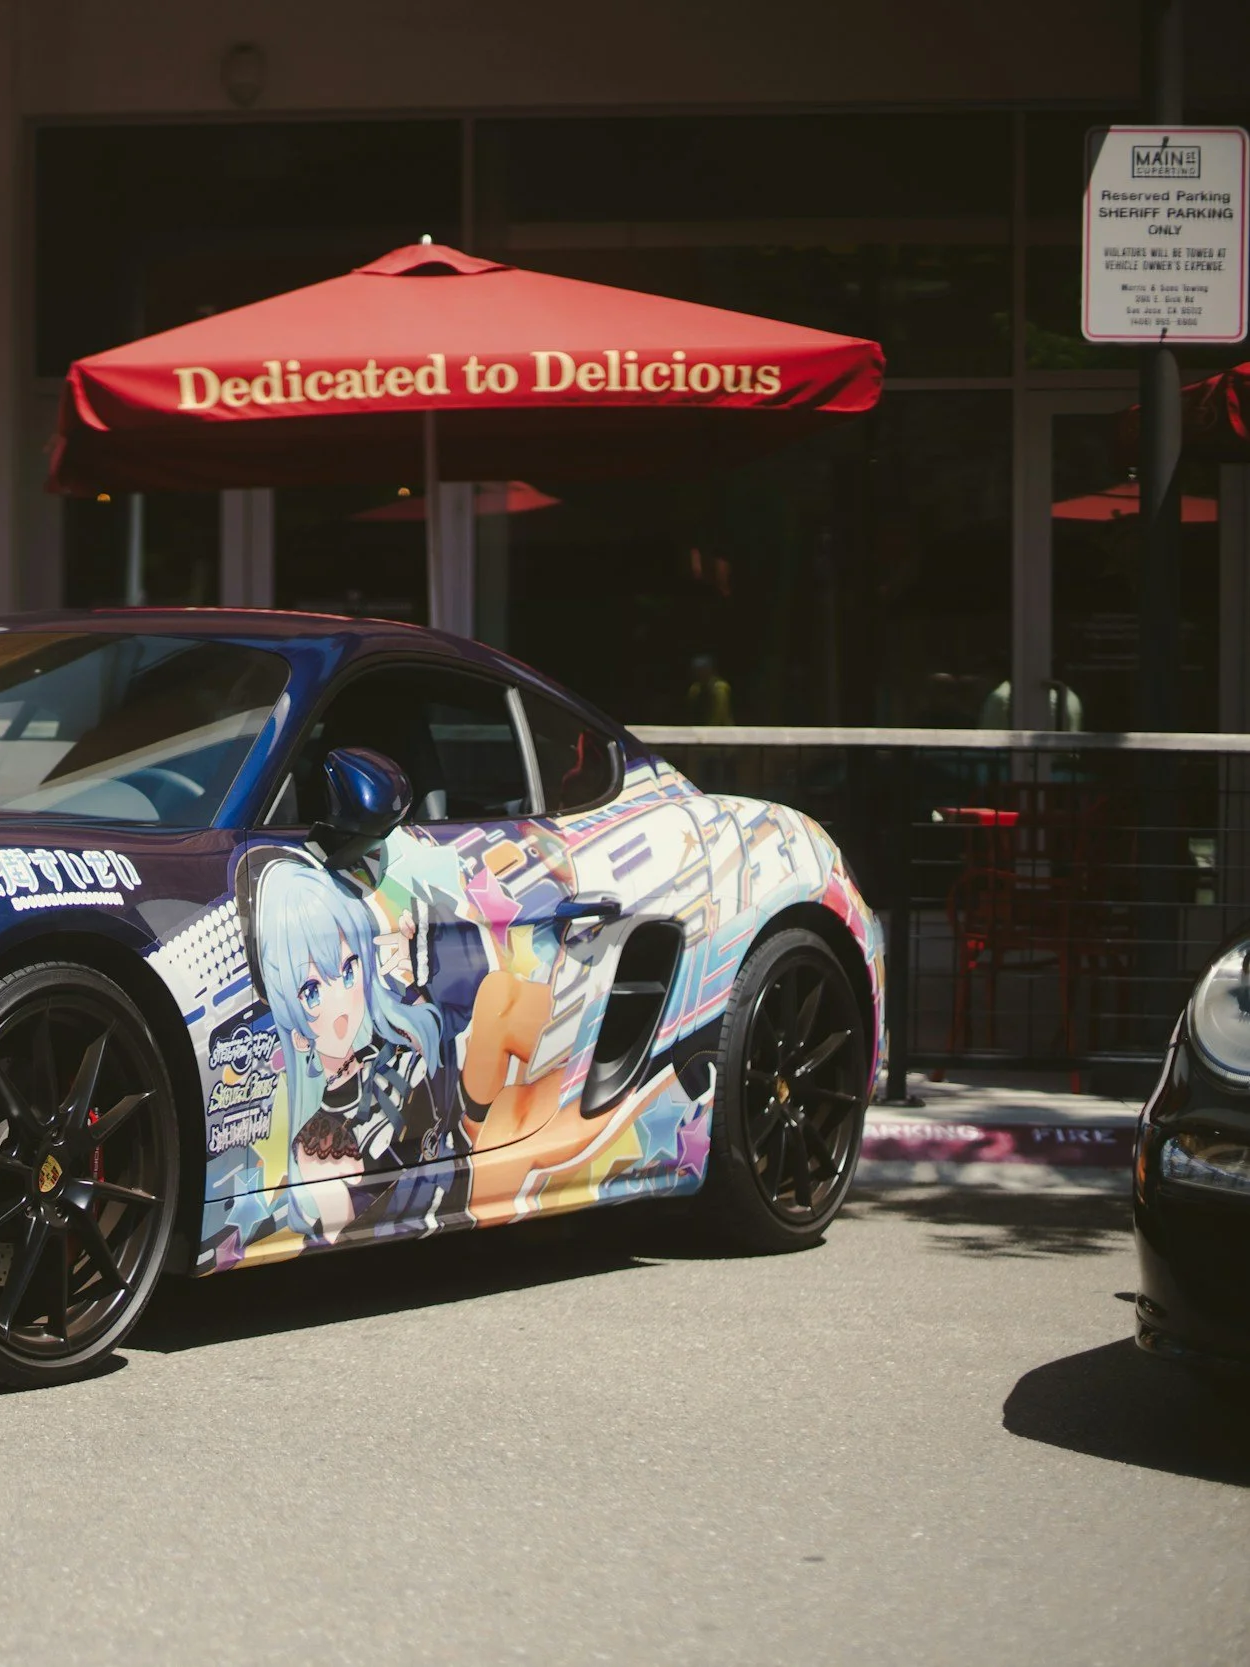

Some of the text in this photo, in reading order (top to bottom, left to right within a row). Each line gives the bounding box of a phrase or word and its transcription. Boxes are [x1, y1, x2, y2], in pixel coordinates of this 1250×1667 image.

[1136, 151, 1183, 166] MAIN
[1137, 167, 1196, 175] CUPERTINO
[1101, 190, 1231, 203] Reserved Parking
[1098, 207, 1234, 219] SHERIFF PARKING
[1148, 224, 1182, 235] ONLY
[1104, 247, 1227, 258] VIOLATORS WILL BE TOWED AT
[1105, 260, 1138, 271] VEHICLE
[1142, 260, 1181, 271] OWNER'S
[173, 349, 781, 411] Dedicated to Delicious
[862, 1123, 1118, 1144] ARKING FIRE
